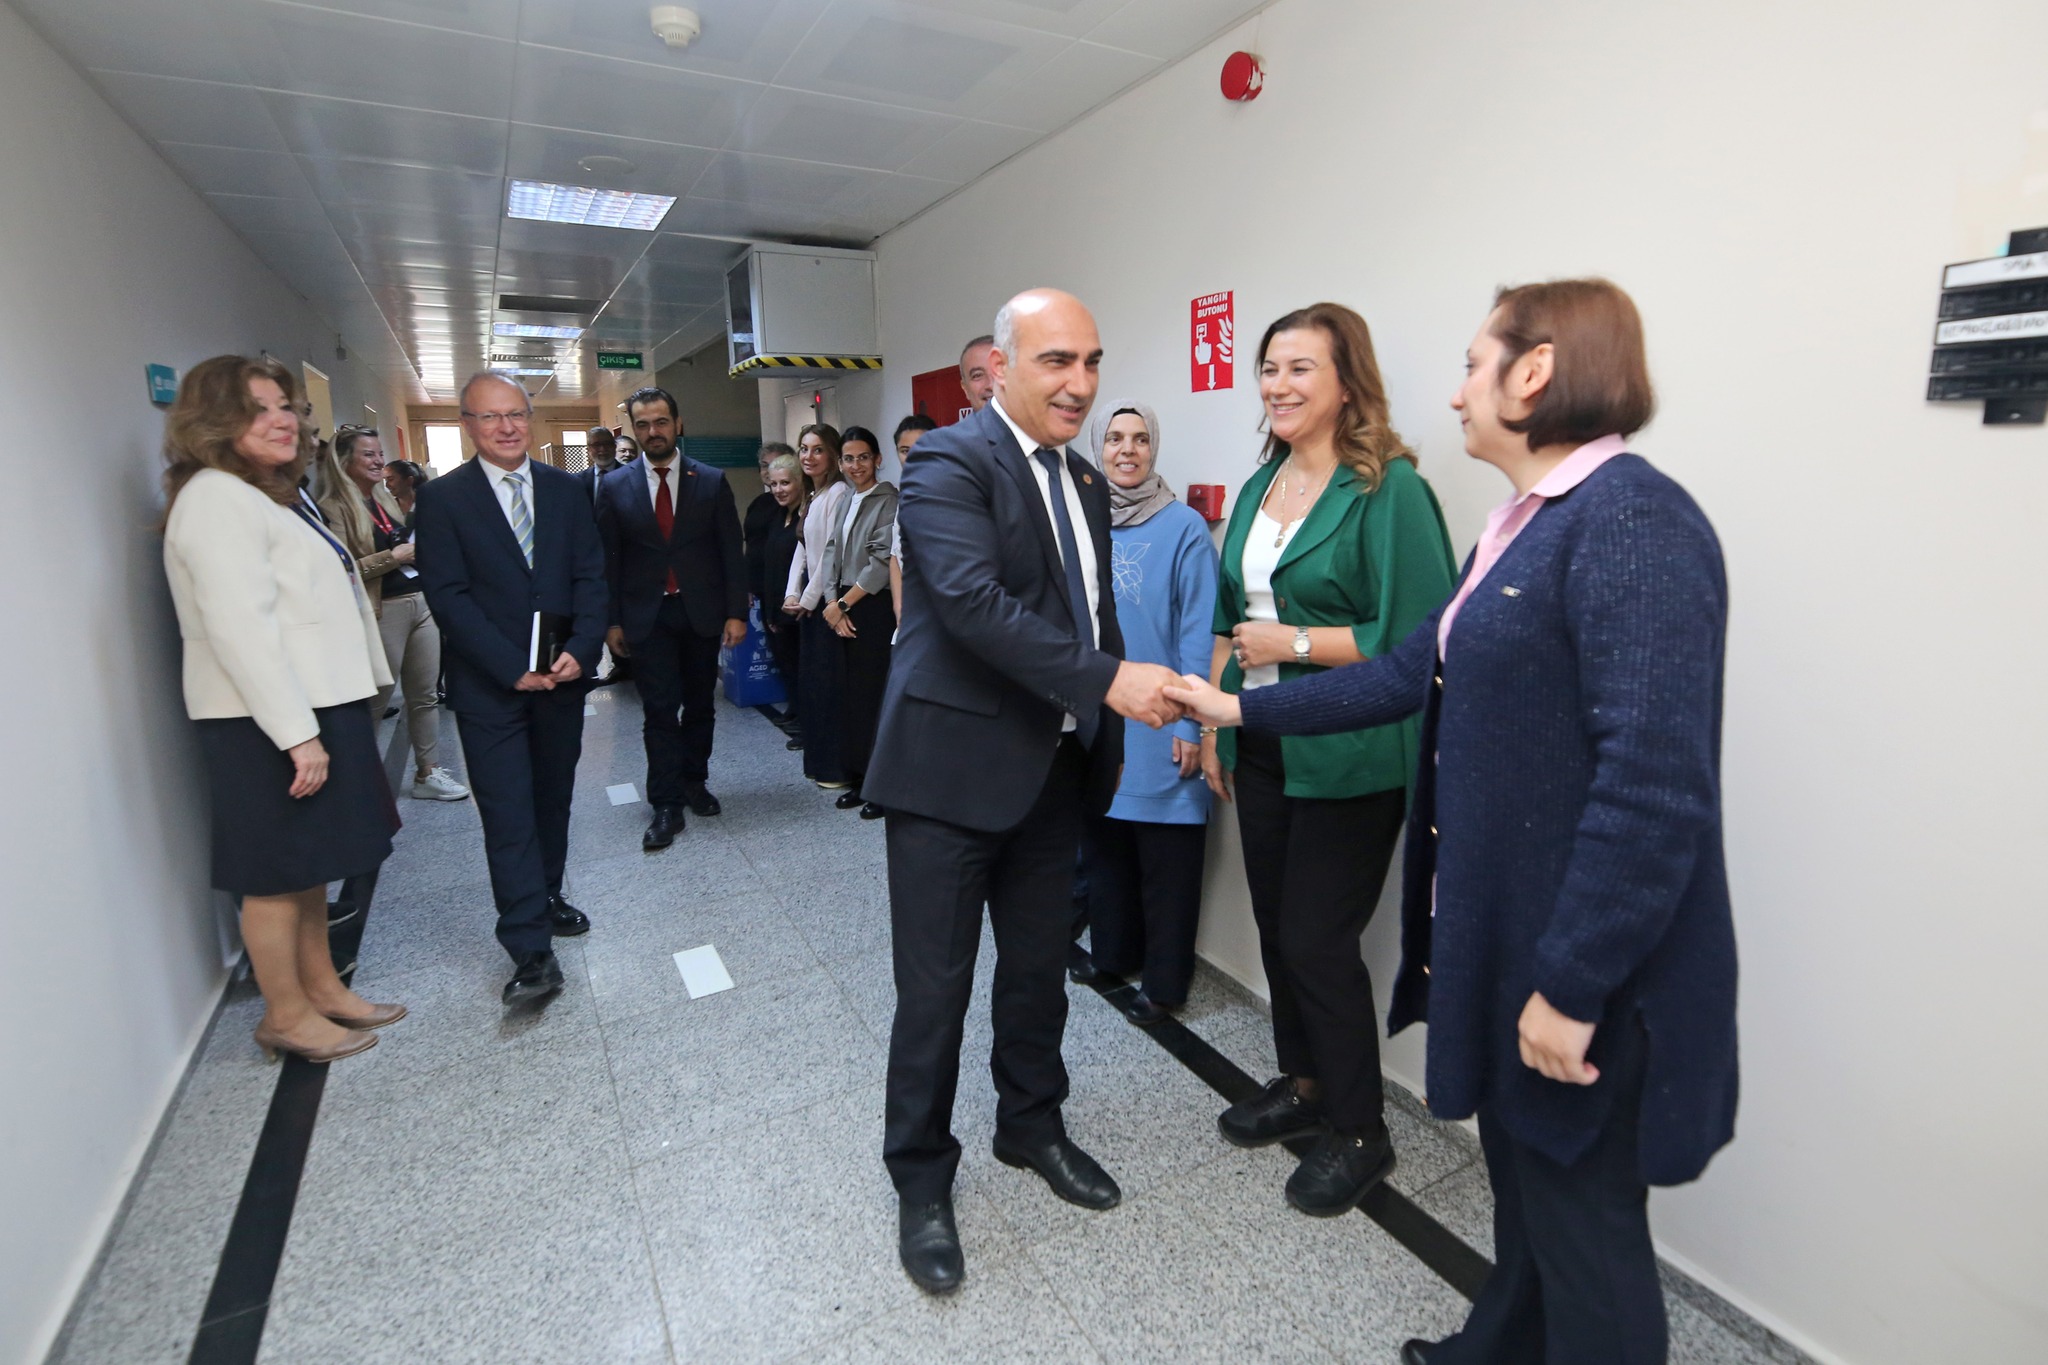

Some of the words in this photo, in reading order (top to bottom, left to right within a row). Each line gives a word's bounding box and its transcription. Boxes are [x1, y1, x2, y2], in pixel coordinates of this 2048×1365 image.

[1197, 291, 1228, 307] YANGIN
[1197, 303, 1228, 319] BUTONU
[599, 355, 625, 366] ÇIKIŞ
